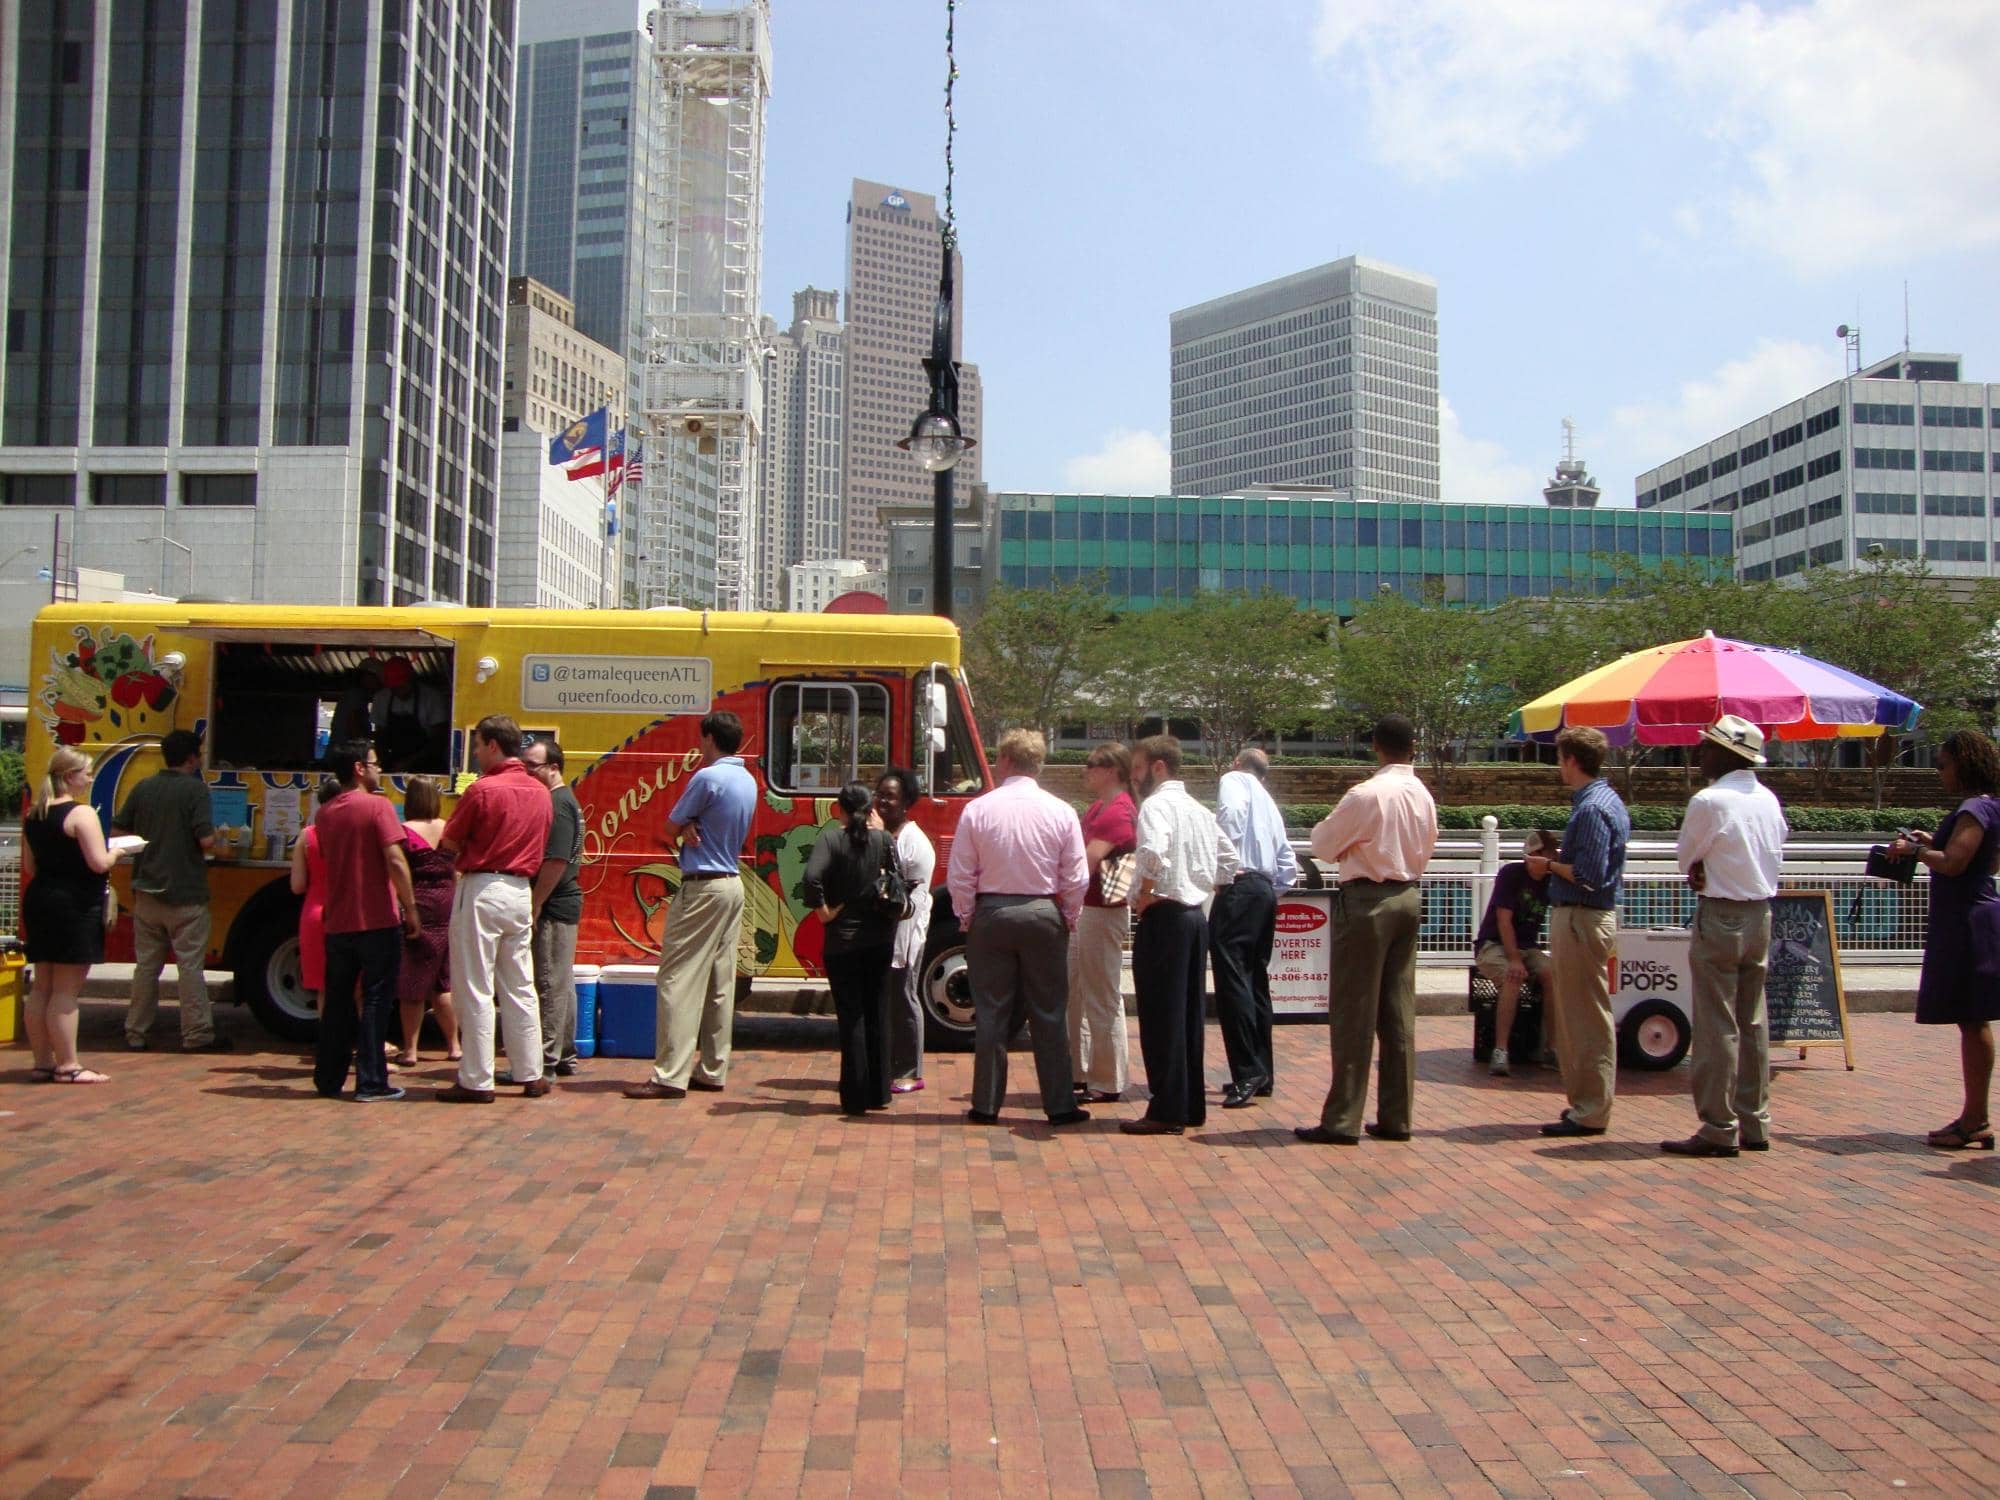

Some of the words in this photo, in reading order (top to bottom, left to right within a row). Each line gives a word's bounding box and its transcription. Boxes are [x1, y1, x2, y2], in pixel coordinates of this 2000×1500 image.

[554, 666, 701, 684] @tamalequeenATL
[558, 689, 696, 705] queenfoodco.com
[1274, 938, 1321, 948] DVERTISE
[1281, 950, 1306, 959] HERE
[1620, 960, 1656, 973] KING
[1620, 973, 1678, 991] POPS
